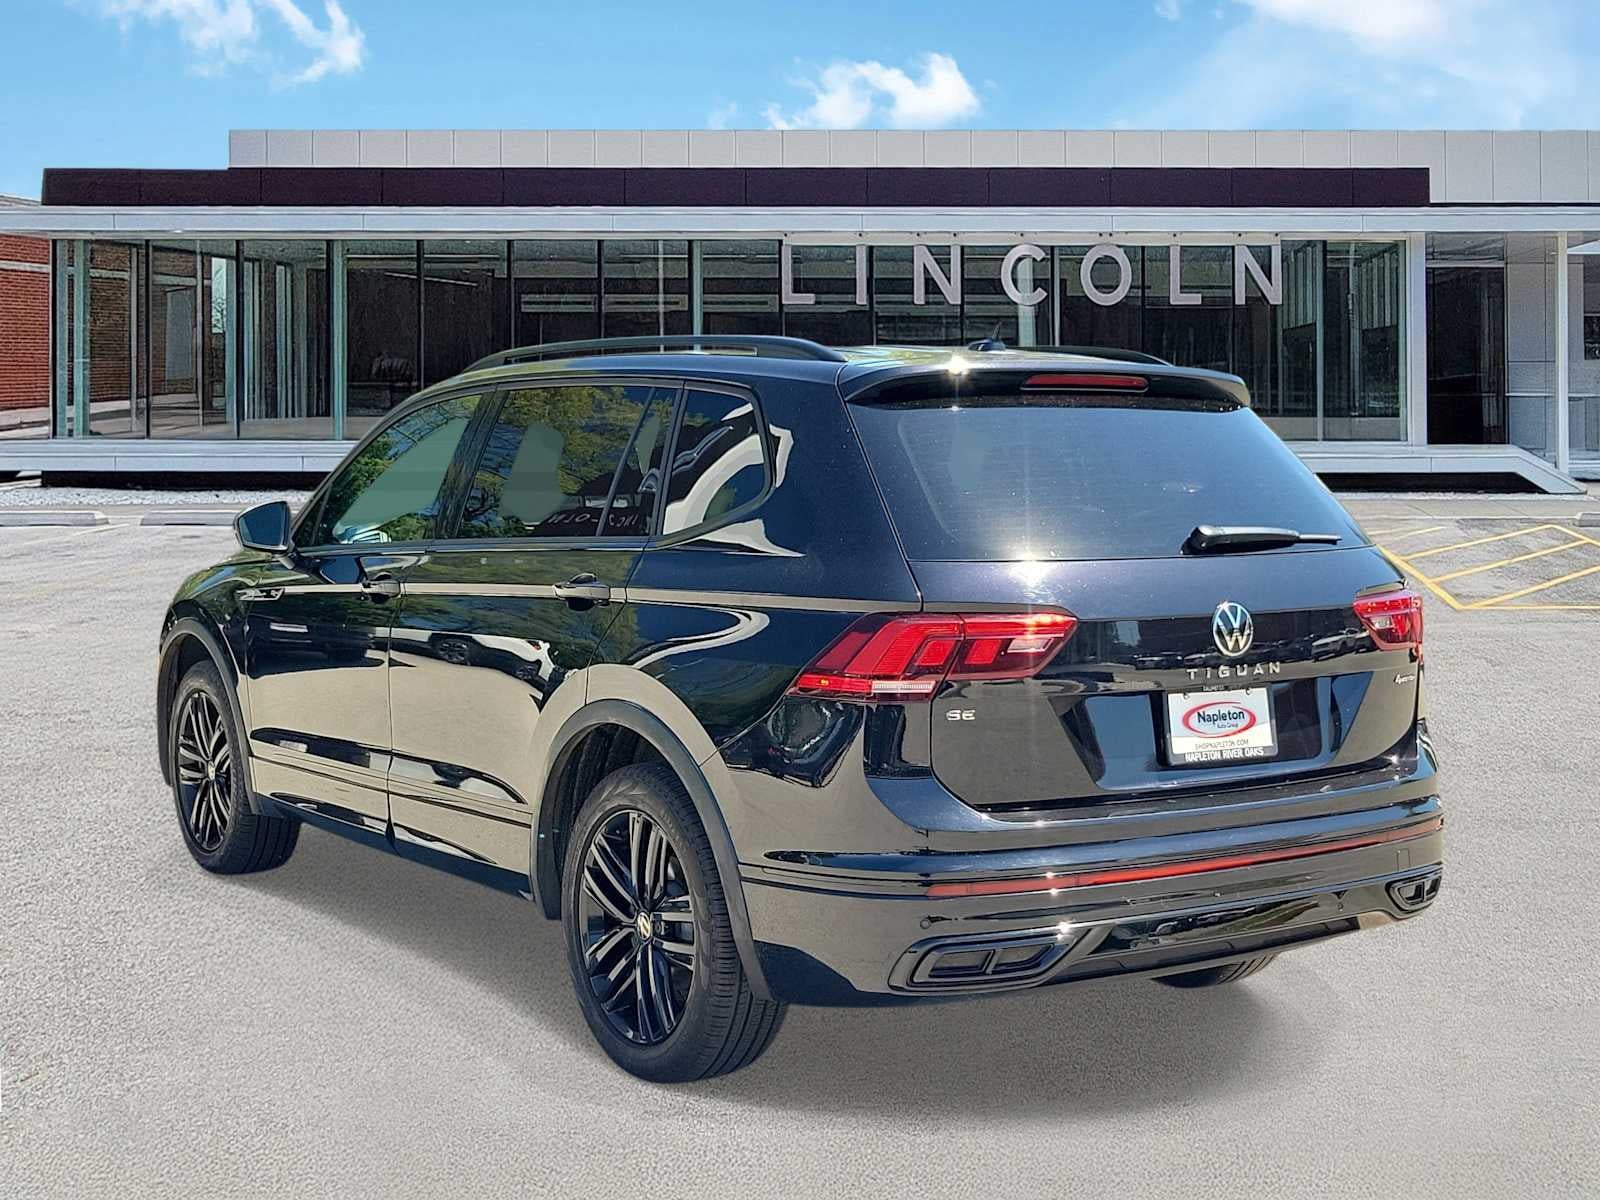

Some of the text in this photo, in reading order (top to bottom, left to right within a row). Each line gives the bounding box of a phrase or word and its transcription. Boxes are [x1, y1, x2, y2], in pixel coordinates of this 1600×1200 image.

[781, 243, 1283, 307] LINCOLN
[1187, 661, 1281, 680] TIGUAN
[946, 709, 976, 721] SE
[1197, 709, 1245, 725] Napleton
[1184, 746, 1265, 762] NAPLETON RIVER OAKS
